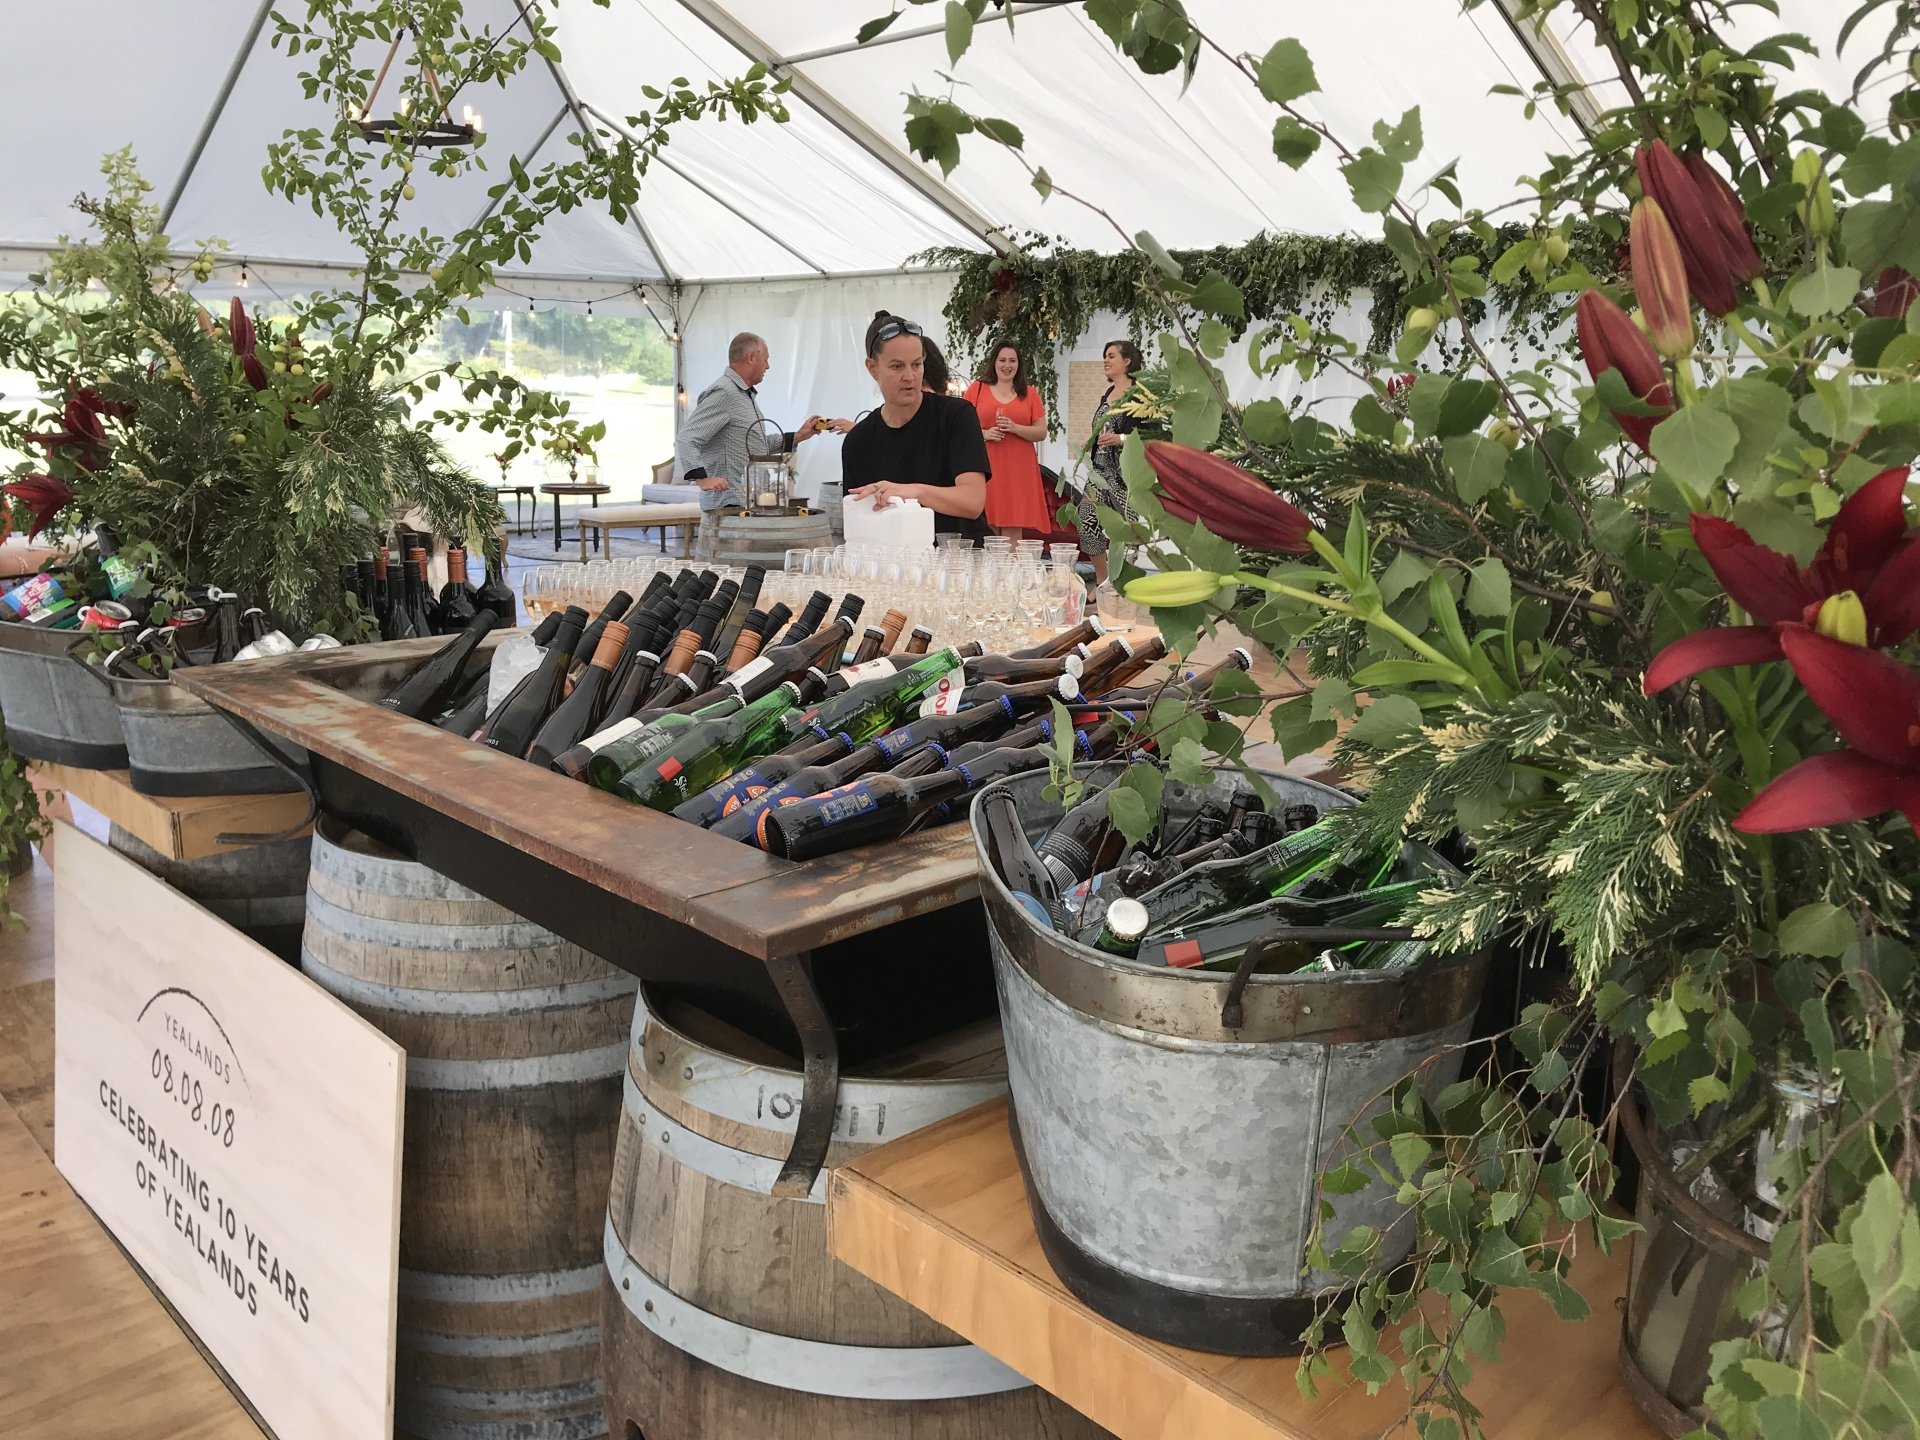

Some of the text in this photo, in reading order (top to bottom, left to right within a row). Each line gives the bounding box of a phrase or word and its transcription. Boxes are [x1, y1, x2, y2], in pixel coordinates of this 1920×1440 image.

[152, 1048, 235, 1148] 08.08.08
[164, 1012, 231, 1085] YEALANDS
[99, 1079, 310, 1324] CELEBRATING 10 YEARS
[136, 1160, 258, 1317] OF YEALANDS
